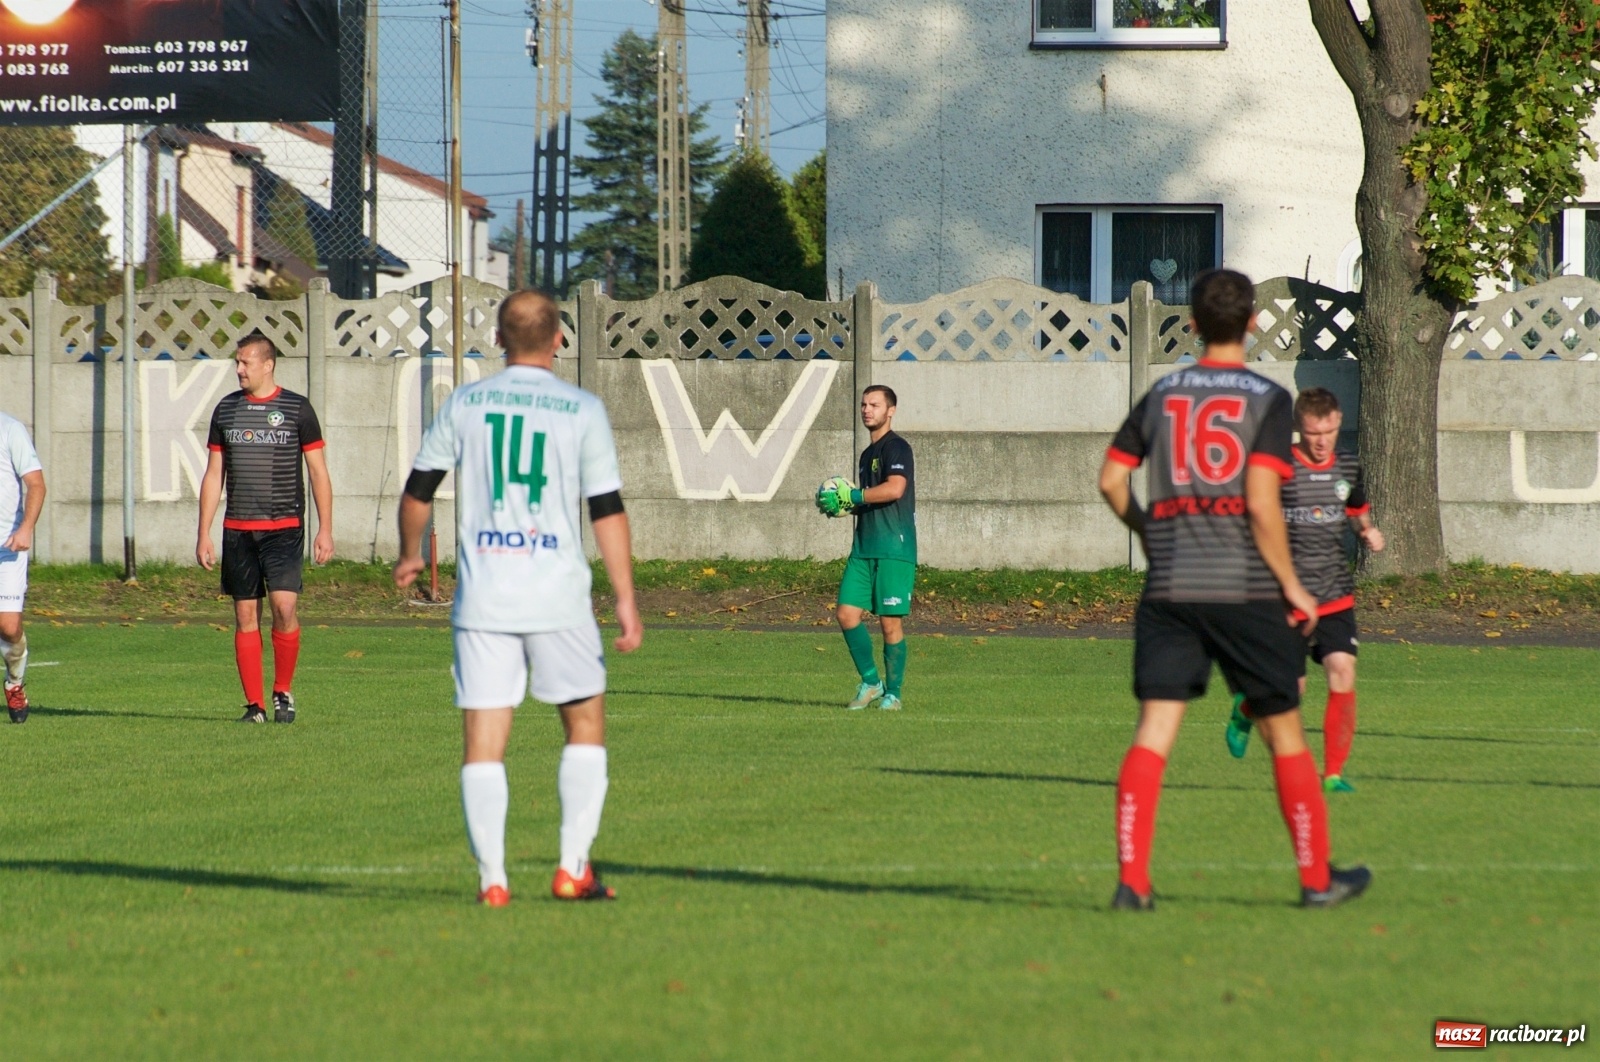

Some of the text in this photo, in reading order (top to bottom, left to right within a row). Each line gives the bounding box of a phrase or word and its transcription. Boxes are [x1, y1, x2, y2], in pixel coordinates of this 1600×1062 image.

[7, 43, 36, 56] 798
[40, 43, 69, 56] 977
[104, 40, 248, 55] Tomasz: 603 798 967
[6, 63, 36, 76] 083
[39, 62, 70, 76] 762
[109, 60, 249, 74] Marcin: 607 336 321
[223, 429, 290, 444] PROSAT
[1163, 394, 1247, 486] 16
[485, 412, 547, 513] 14
